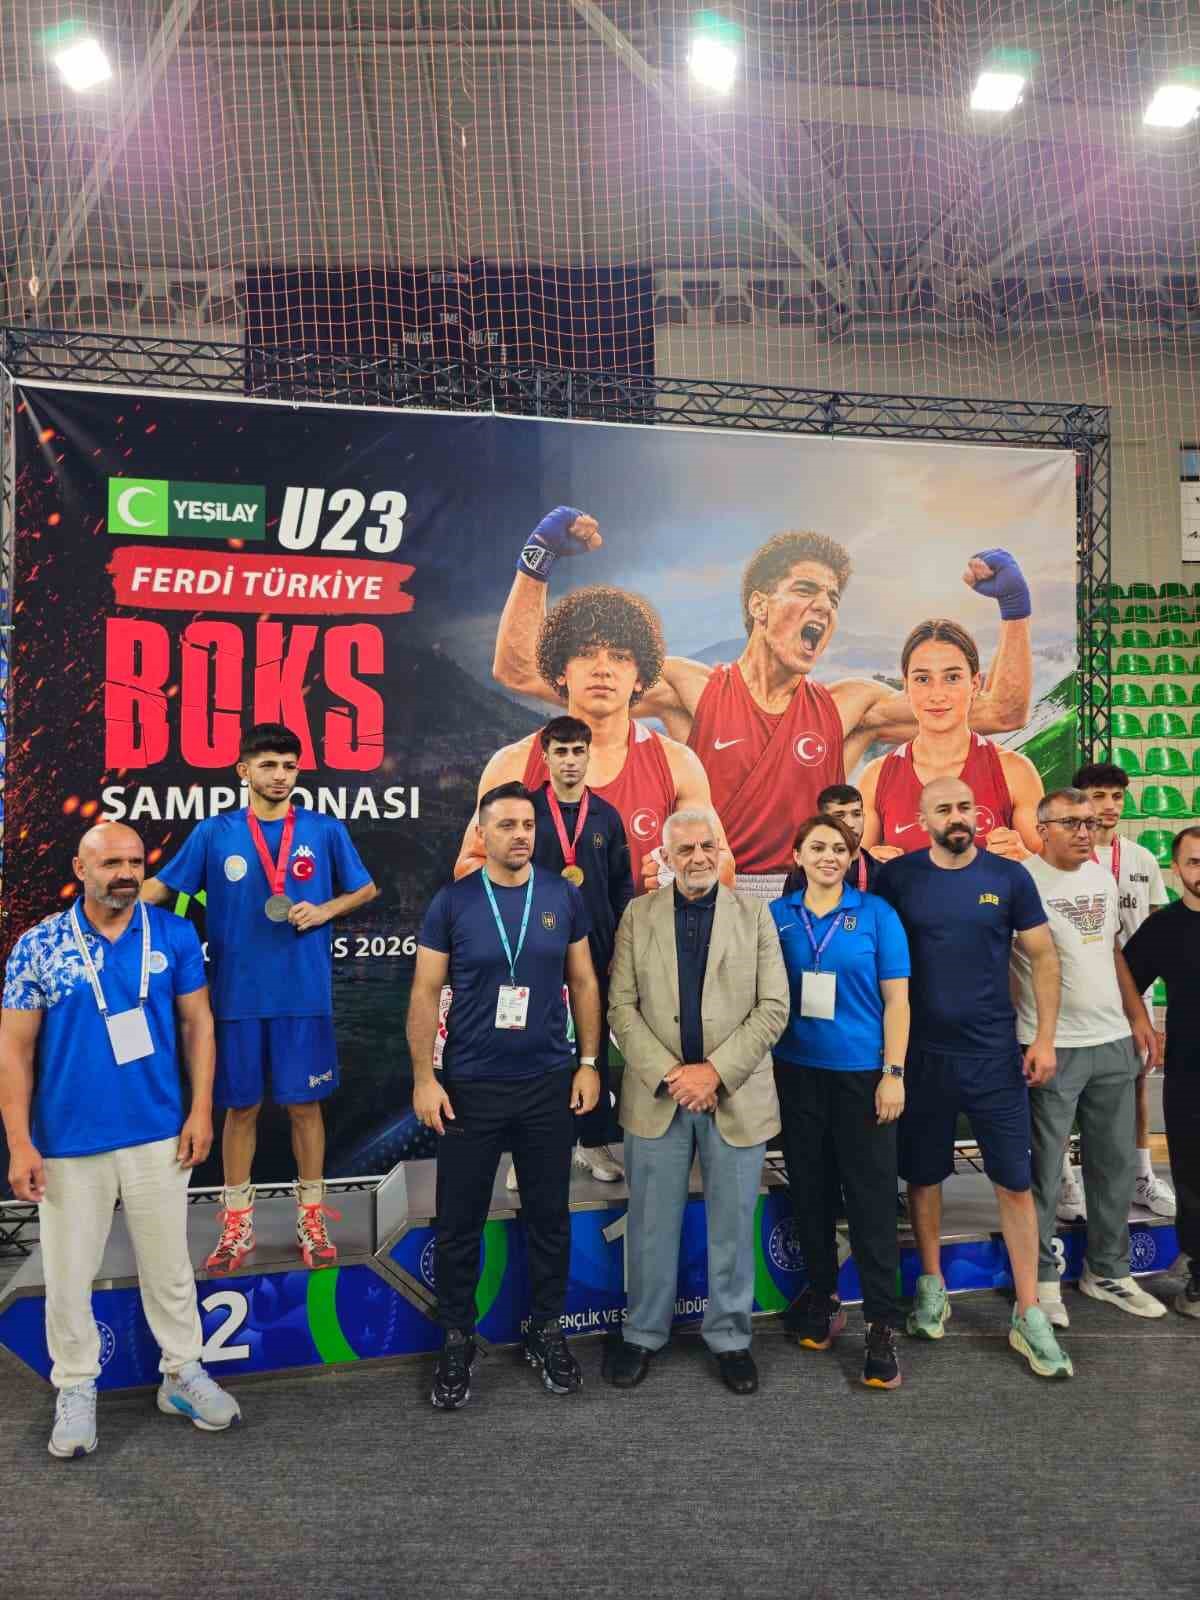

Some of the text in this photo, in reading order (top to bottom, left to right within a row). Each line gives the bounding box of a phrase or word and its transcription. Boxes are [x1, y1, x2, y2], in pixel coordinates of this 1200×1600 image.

[278, 486, 408, 553] U23
[131, 566, 384, 600] FERDİ TÜRKİYE
[104, 617, 385, 772] BOKS
[355, 935, 417, 957] 2026
[200, 1291, 250, 1363] 2
[558, 1307, 600, 1330] ENÇLİK
